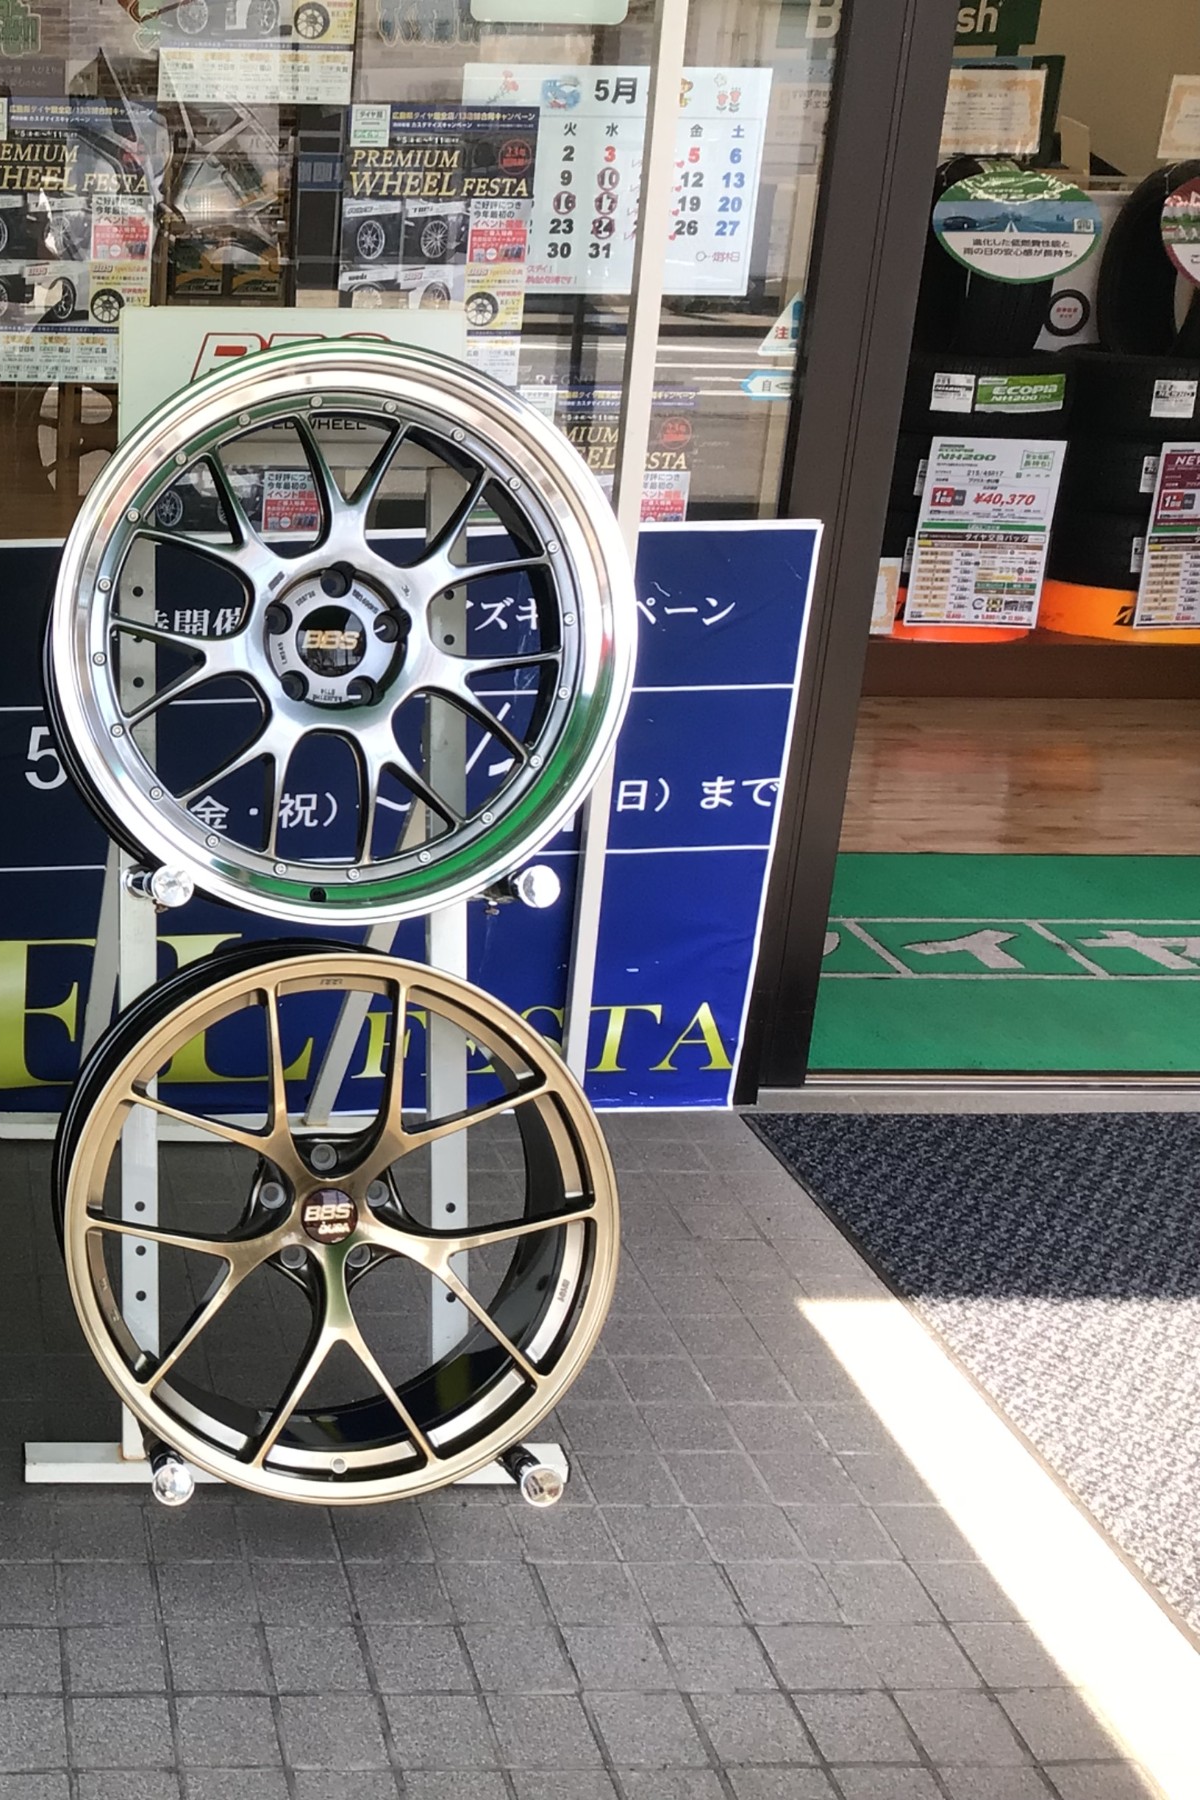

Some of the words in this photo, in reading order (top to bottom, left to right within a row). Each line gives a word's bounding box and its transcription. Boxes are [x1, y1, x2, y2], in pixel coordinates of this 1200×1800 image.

[594, 77, 638, 105] 5月
[563, 122, 577, 137] 火
[605, 122, 620, 137] 水
[690, 124, 704, 139] 金
[731, 125, 745, 139] 土
[352, 150, 461, 168] PREMIUM
[562, 146, 575, 163] 2
[604, 146, 617, 163] 3
[688, 147, 701, 164] 5
[729, 148, 742, 164] 6
[81, 173, 150, 193] FESTA
[350, 171, 456, 196] WHEEL
[460, 178, 529, 197] FESTA
[560, 170, 573, 186] 9
[599, 172, 619, 188] 10
[681, 172, 705, 189] 12
[722, 172, 746, 189] 13
[555, 195, 575, 211] 16
[596, 195, 618, 211] 17
[678, 196, 701, 213] 19
[718, 196, 743, 213] 20
[549, 218, 574, 235] 23
[591, 219, 615, 235] 24
[674, 220, 698, 236] 26
[715, 220, 740, 237] 27
[547, 242, 572, 259] 30
[588, 243, 613, 259] 31
[937, 453, 997, 461] NH200
[973, 492, 1036, 506] ¥40,370
[301, 629, 361, 651] BBS
[304, 1203, 355, 1222] BBS
